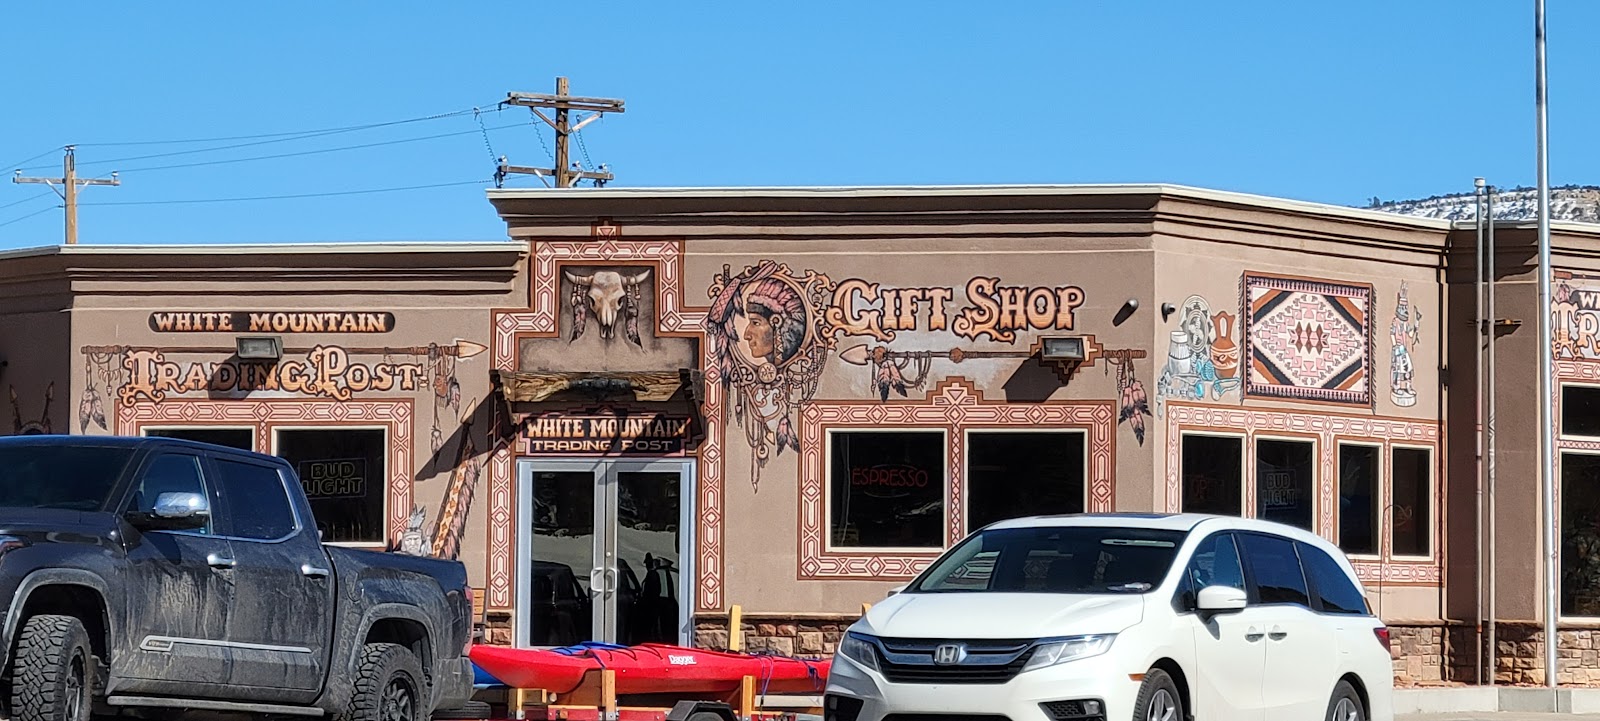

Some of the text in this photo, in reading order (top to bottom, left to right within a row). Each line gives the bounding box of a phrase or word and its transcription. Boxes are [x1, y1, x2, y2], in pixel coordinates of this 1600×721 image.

[825, 275, 1085, 343] GIFT SHOP
[153, 312, 386, 332] WHITE MOUNTAIN
[117, 344, 423, 407] TRADING POST
[526, 417, 686, 438] WHITE MOUNTAIN
[532, 440, 673, 451] TRADING POST
[311, 461, 355, 480] BUD
[851, 467, 928, 488] ESPRESSO
[302, 477, 363, 495] LIGHT
[1266, 472, 1291, 489] BUD
[668, 654, 697, 666] Dagger
